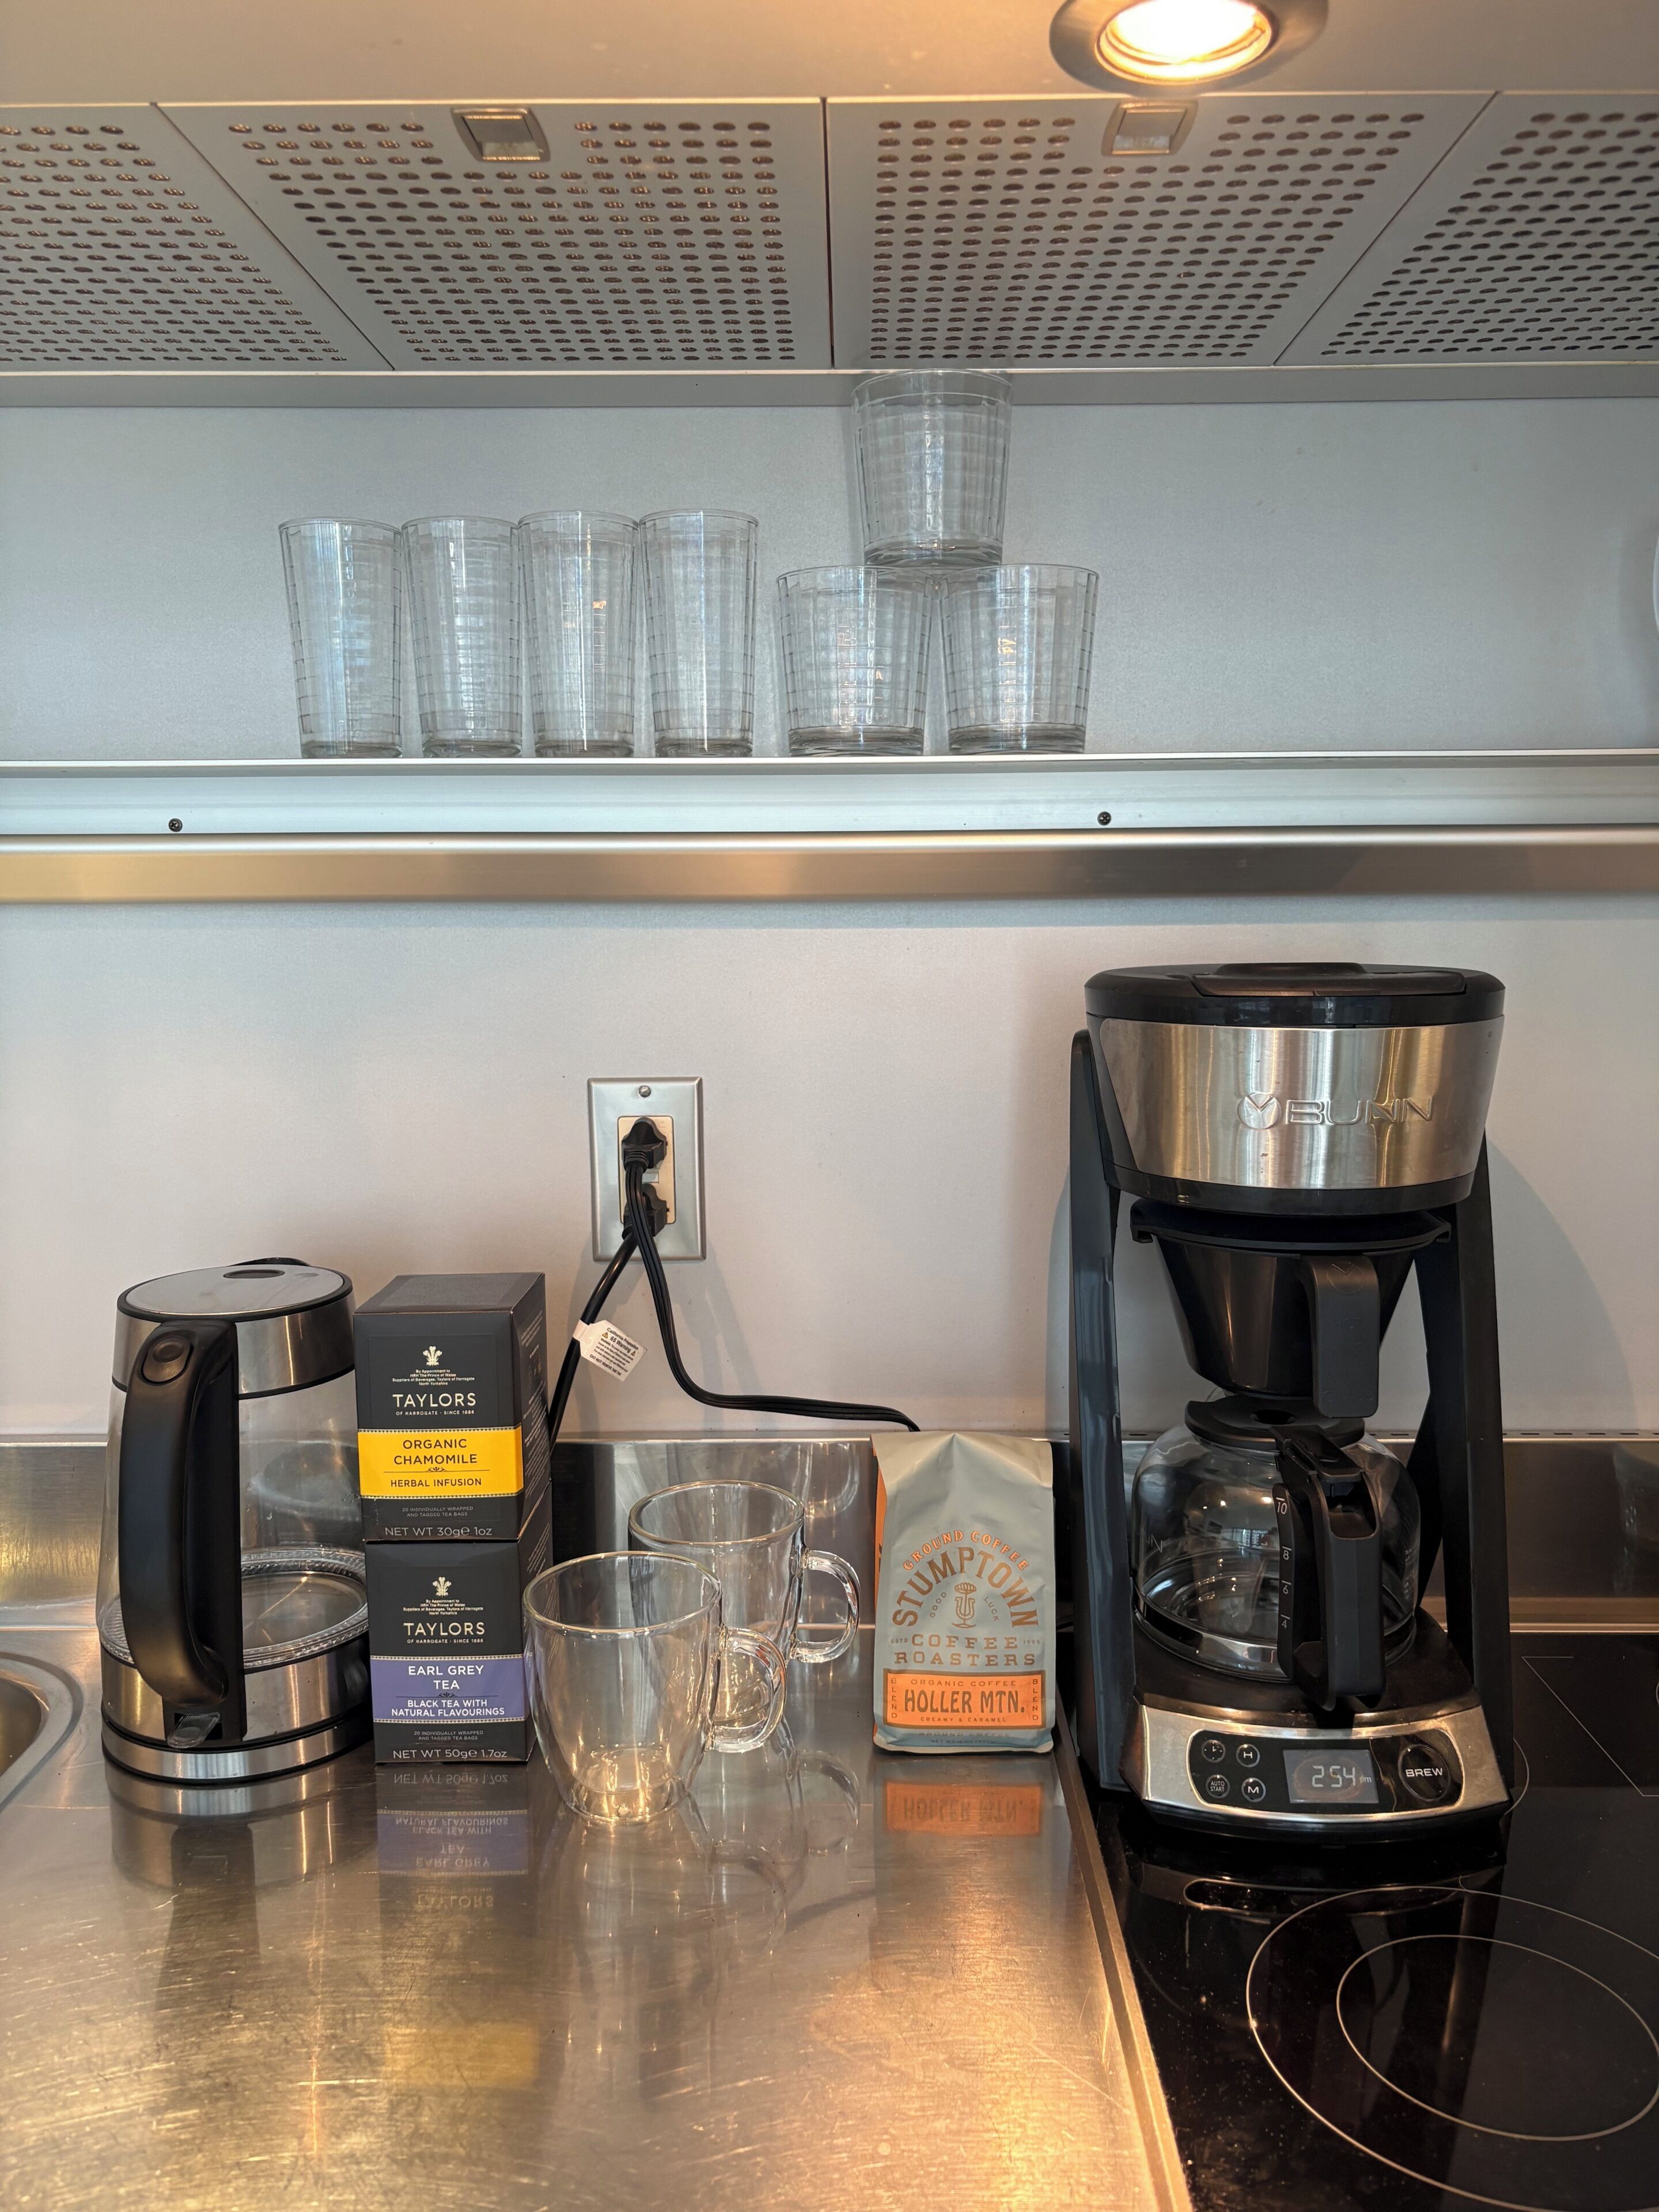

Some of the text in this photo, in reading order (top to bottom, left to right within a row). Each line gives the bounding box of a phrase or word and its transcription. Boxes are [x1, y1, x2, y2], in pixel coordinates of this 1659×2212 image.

[1285, 1097, 1433, 1124] BUNN
[616, 1339, 631, 1353] Warning
[392, 1393, 476, 1407] TAYLORS
[403, 1439, 467, 1449] ORGANIC
[394, 1454, 478, 1464] CHAMOMILE
[434, 1478, 482, 1487] INFUSION
[1277, 1502, 1287, 1514] 10
[385, 1527, 408, 1536] NET
[412, 1527, 433, 1536] WT
[474, 1527, 493, 1536] 1oz
[903, 1530, 964, 1571] GROUND
[971, 1531, 1029, 1571] COFFEE
[1283, 1550, 1289, 1560] 8
[892, 1546, 1039, 1628] STUMPTOWN
[1283, 1585, 1289, 1594] 6
[930, 1592, 947, 1618] GOOD
[984, 1596, 999, 1622] LUCK
[403, 1622, 485, 1635] TAYLORS
[1282, 1619, 1287, 1629] 4
[911, 1634, 1017, 1650] COFFEE
[894, 1651, 1035, 1666] ROASTERS
[408, 1665, 484, 1675] EARL GREY
[433, 1680, 460, 1690] TEA
[904, 1690, 1024, 1713] HOLLER MTN.
[438, 1707, 505, 1716] FLAVOURINGS
[393, 1750, 417, 1759] NET
[421, 1749, 441, 1758] WT
[481, 1749, 507, 1758] 1.7oz
[1405, 1768, 1443, 1777] BREW
